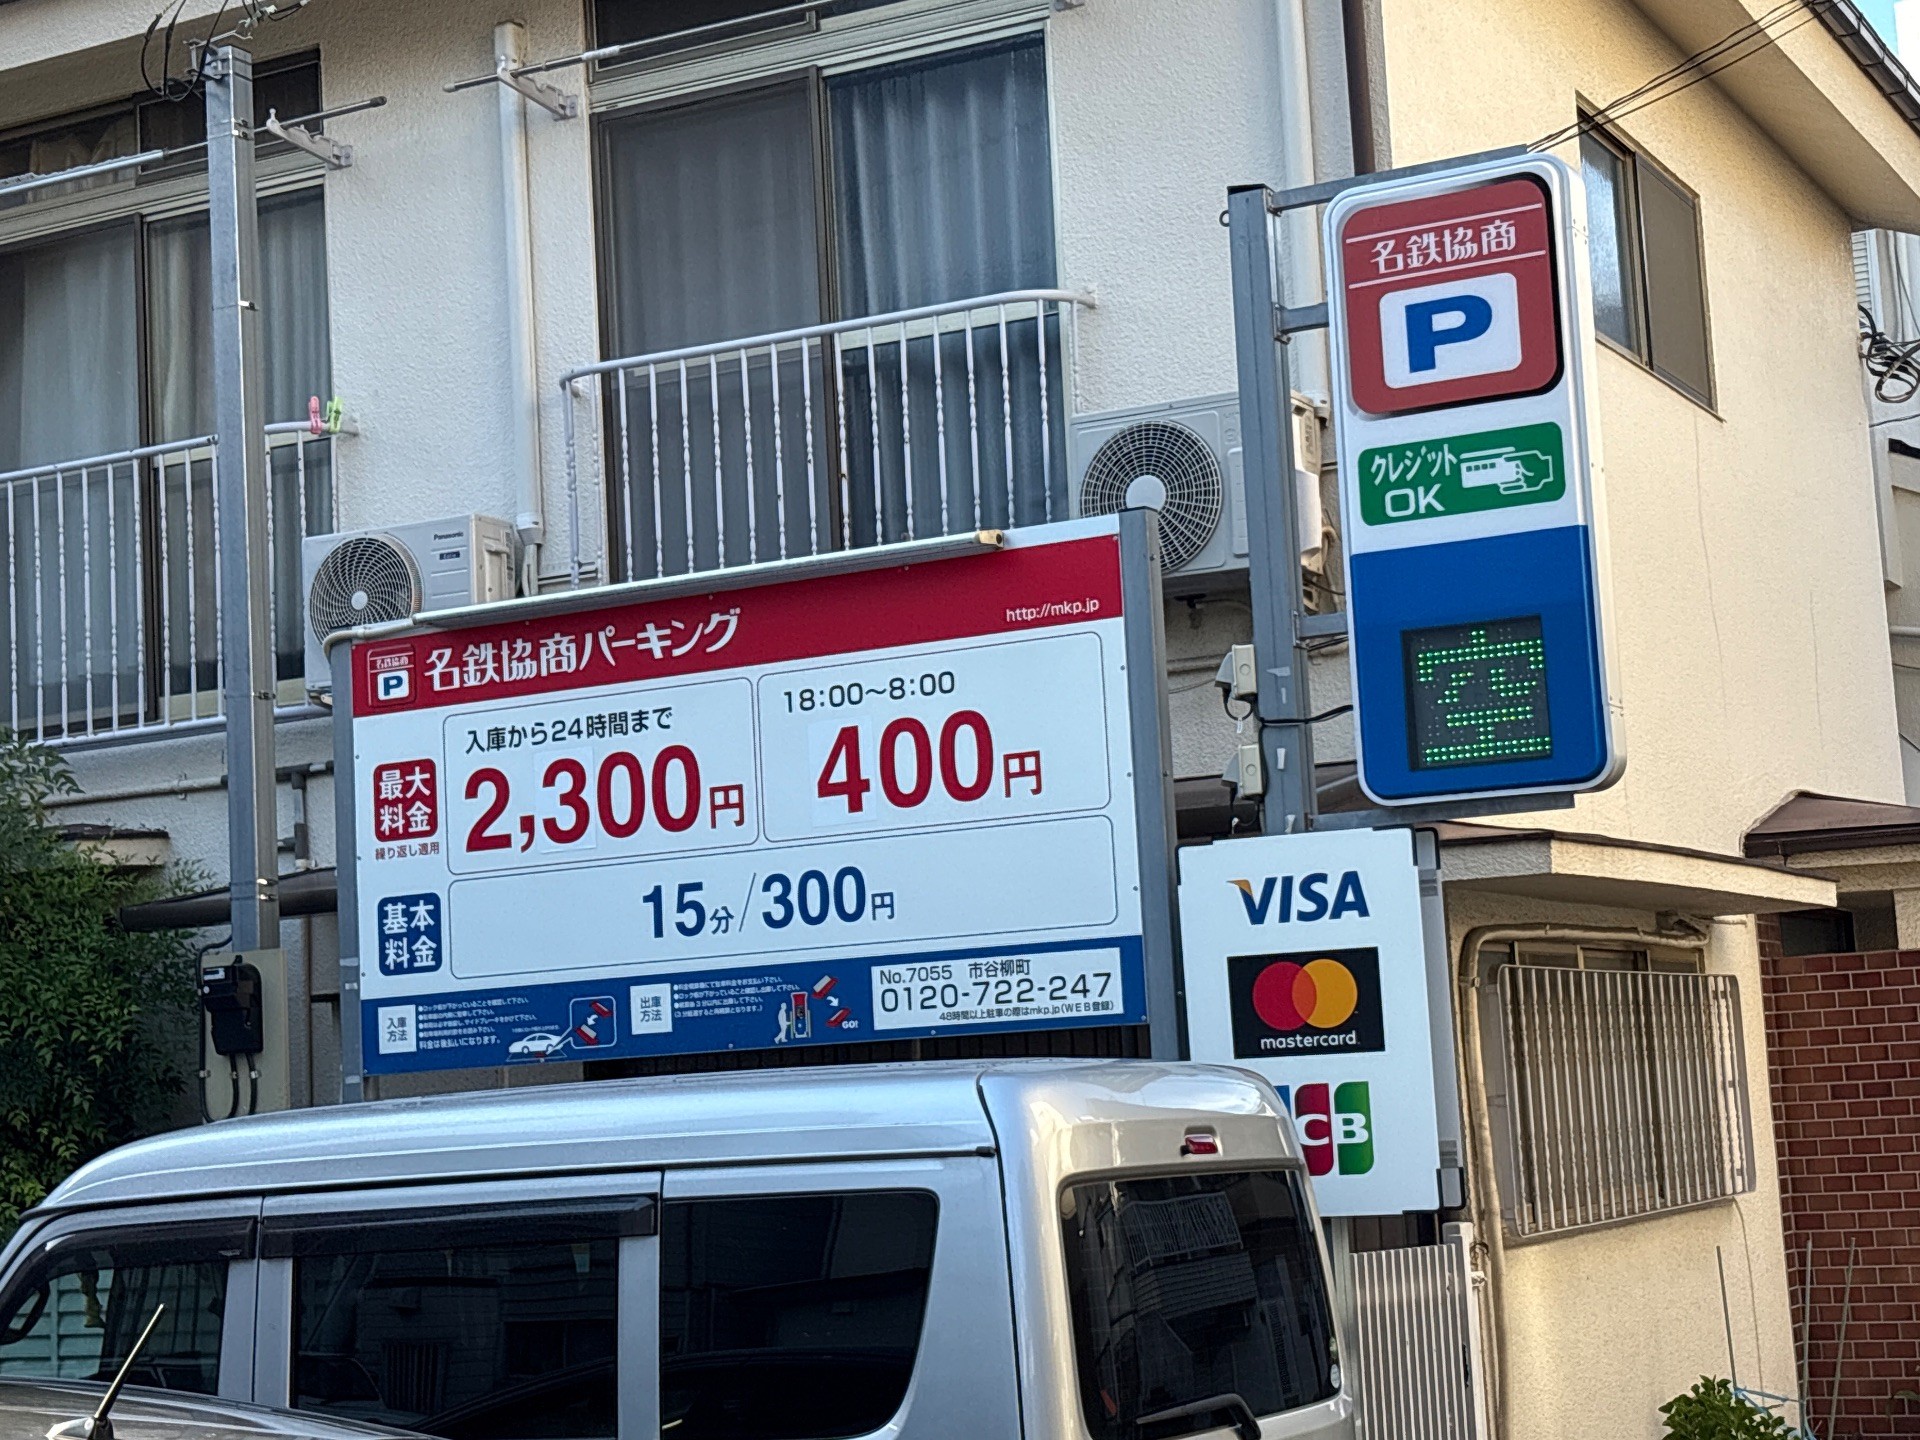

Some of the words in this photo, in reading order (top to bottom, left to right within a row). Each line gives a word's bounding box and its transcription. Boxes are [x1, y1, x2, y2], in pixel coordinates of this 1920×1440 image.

[1370, 219, 1516, 275] 名鉄協商
[1405, 294, 1492, 373] P
[1370, 443, 1458, 487] クレジット
[1385, 483, 1446, 518] OK
[1006, 597, 1100, 623] http://mkp.jp
[424, 606, 741, 692] 名鉄協商パーキング
[383, 675, 403, 696] P
[465, 707, 673, 755] 入庫から24時間まで
[816, 709, 1043, 814] 400円
[378, 766, 432, 802] 最大
[464, 744, 746, 853] 2,300円
[378, 801, 434, 837] 料金
[1226, 870, 1370, 925] VISA
[382, 901, 437, 934] 基本
[383, 936, 437, 970] 料金
[880, 964, 953, 985] No.7055
[967, 959, 1031, 980] 市谷柳町
[880, 971, 1112, 1013] 0120-722-247
[640, 1009, 663, 1023] 方法
[387, 1030, 408, 1042] 方法
[1260, 1030, 1357, 1051] mastercard
